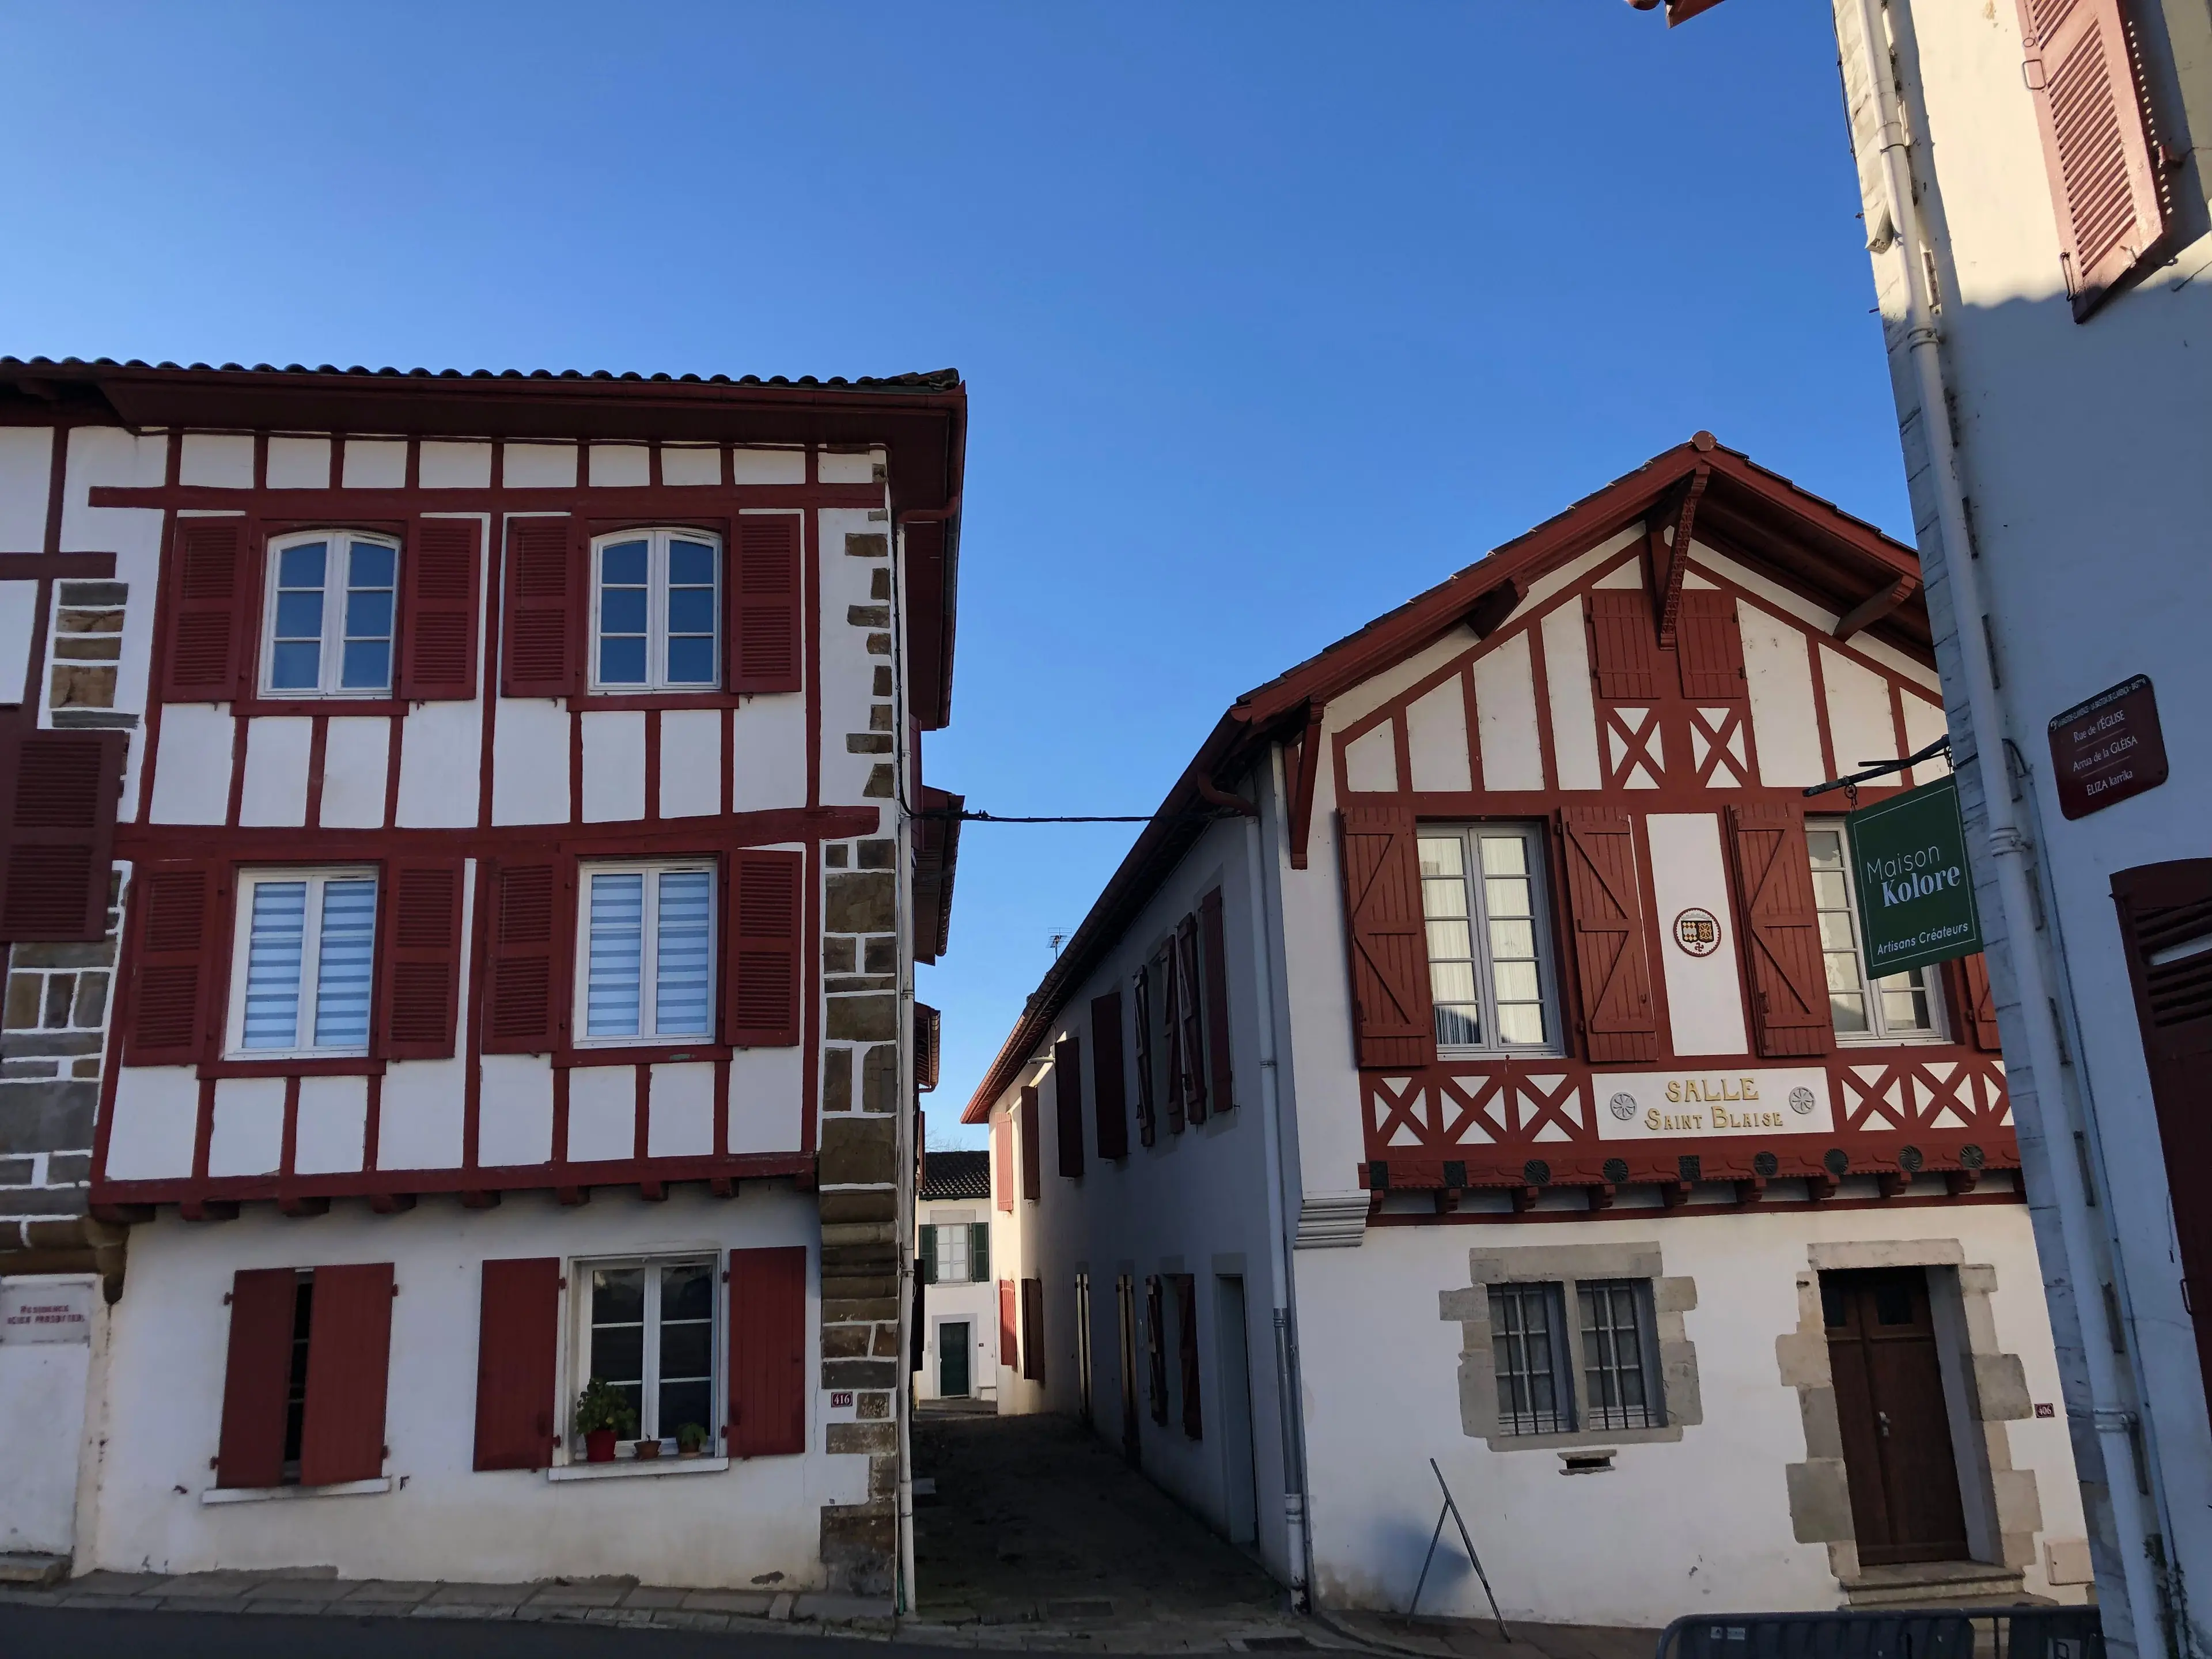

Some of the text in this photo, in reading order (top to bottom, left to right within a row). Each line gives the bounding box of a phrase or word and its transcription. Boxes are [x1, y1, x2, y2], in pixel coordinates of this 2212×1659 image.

[2074, 730, 2086, 743] Rue
[2087, 726, 2096, 736] de
[2093, 752, 2101, 762] de
[2103, 748, 2109, 757] la
[2086, 770, 2133, 796] ELIZA karrika
[1866, 845, 1940, 884] Maison
[1881, 865, 1960, 907] Kolore
[1877, 922, 1968, 955] Artisans Créateurs
[1665, 1078, 1759, 1103] SALLE
[834, 1394, 850, 1404] 416
